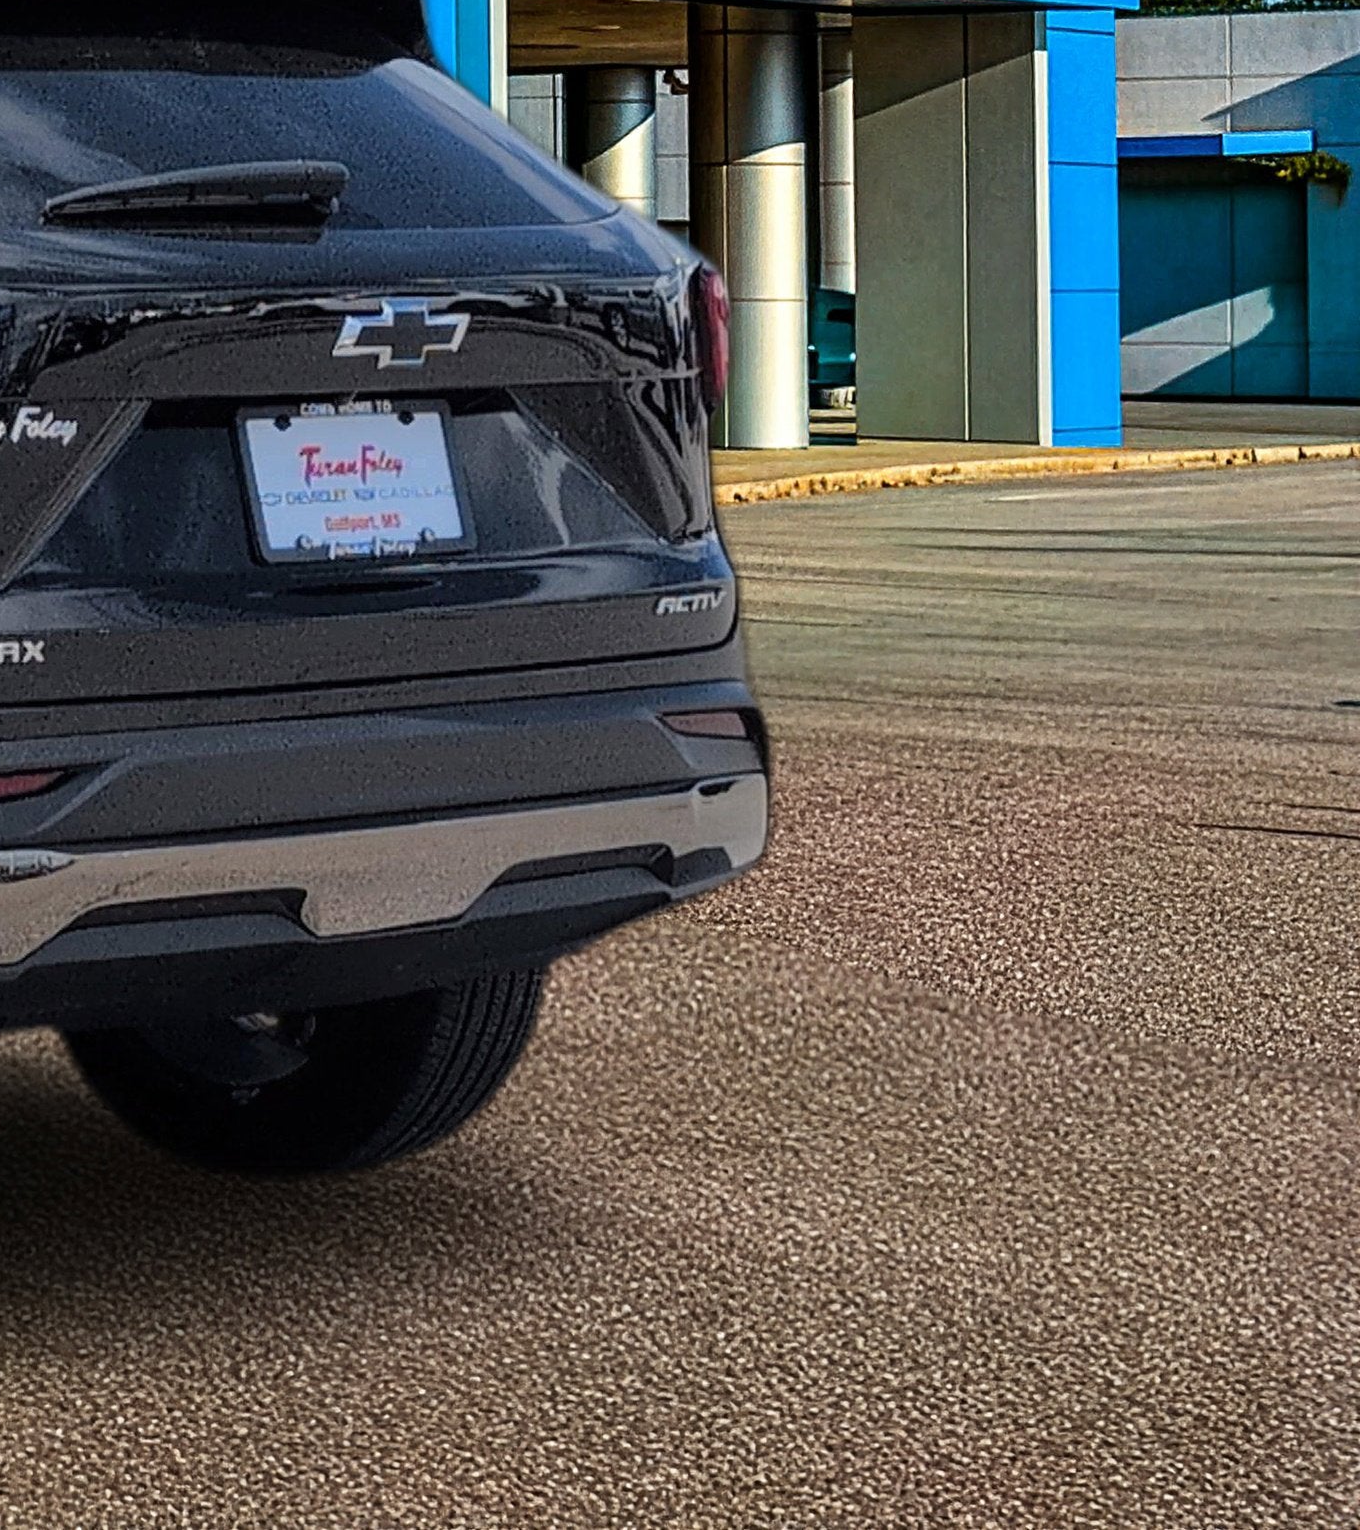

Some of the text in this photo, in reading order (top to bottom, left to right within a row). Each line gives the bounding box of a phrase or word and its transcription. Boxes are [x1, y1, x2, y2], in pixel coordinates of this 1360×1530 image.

[10, 406, 78, 446] Foley
[299, 444, 403, 489] Turan Foley
[655, 590, 728, 615] ACTIV
